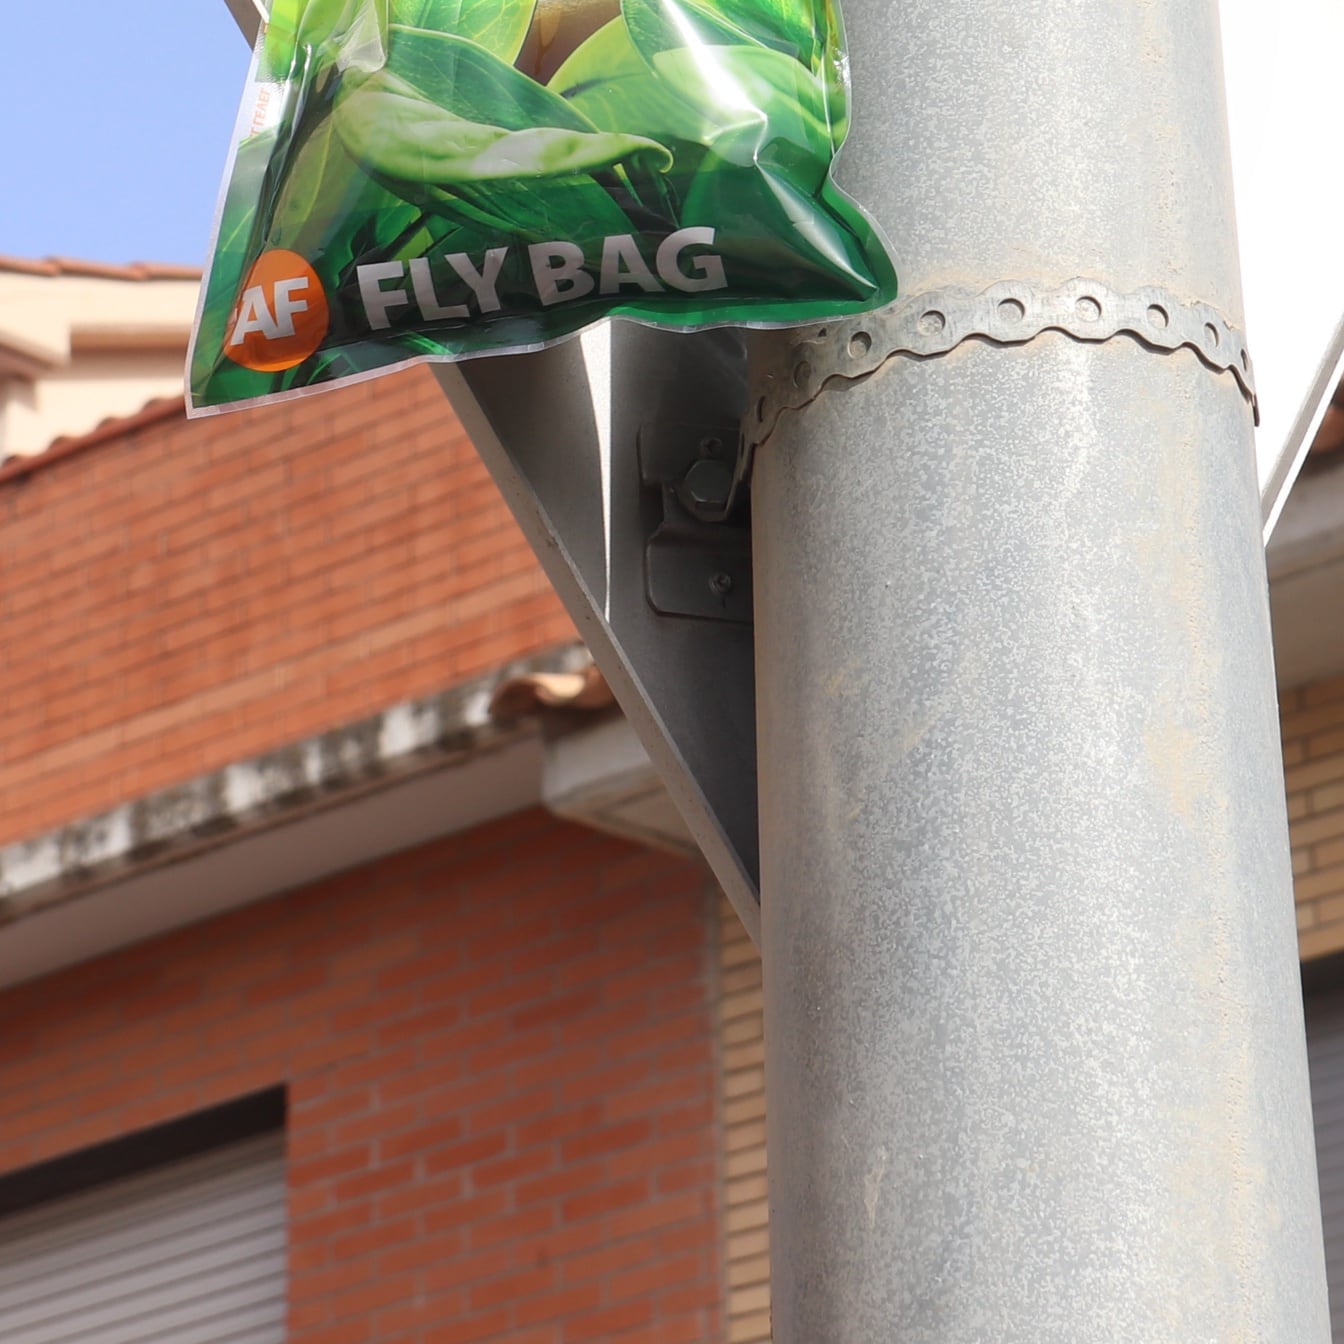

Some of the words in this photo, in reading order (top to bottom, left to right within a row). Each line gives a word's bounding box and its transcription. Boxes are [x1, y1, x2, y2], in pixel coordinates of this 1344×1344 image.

[230, 276, 309, 346] AF
[357, 246, 508, 331] FLY
[527, 225, 729, 309] BAG
